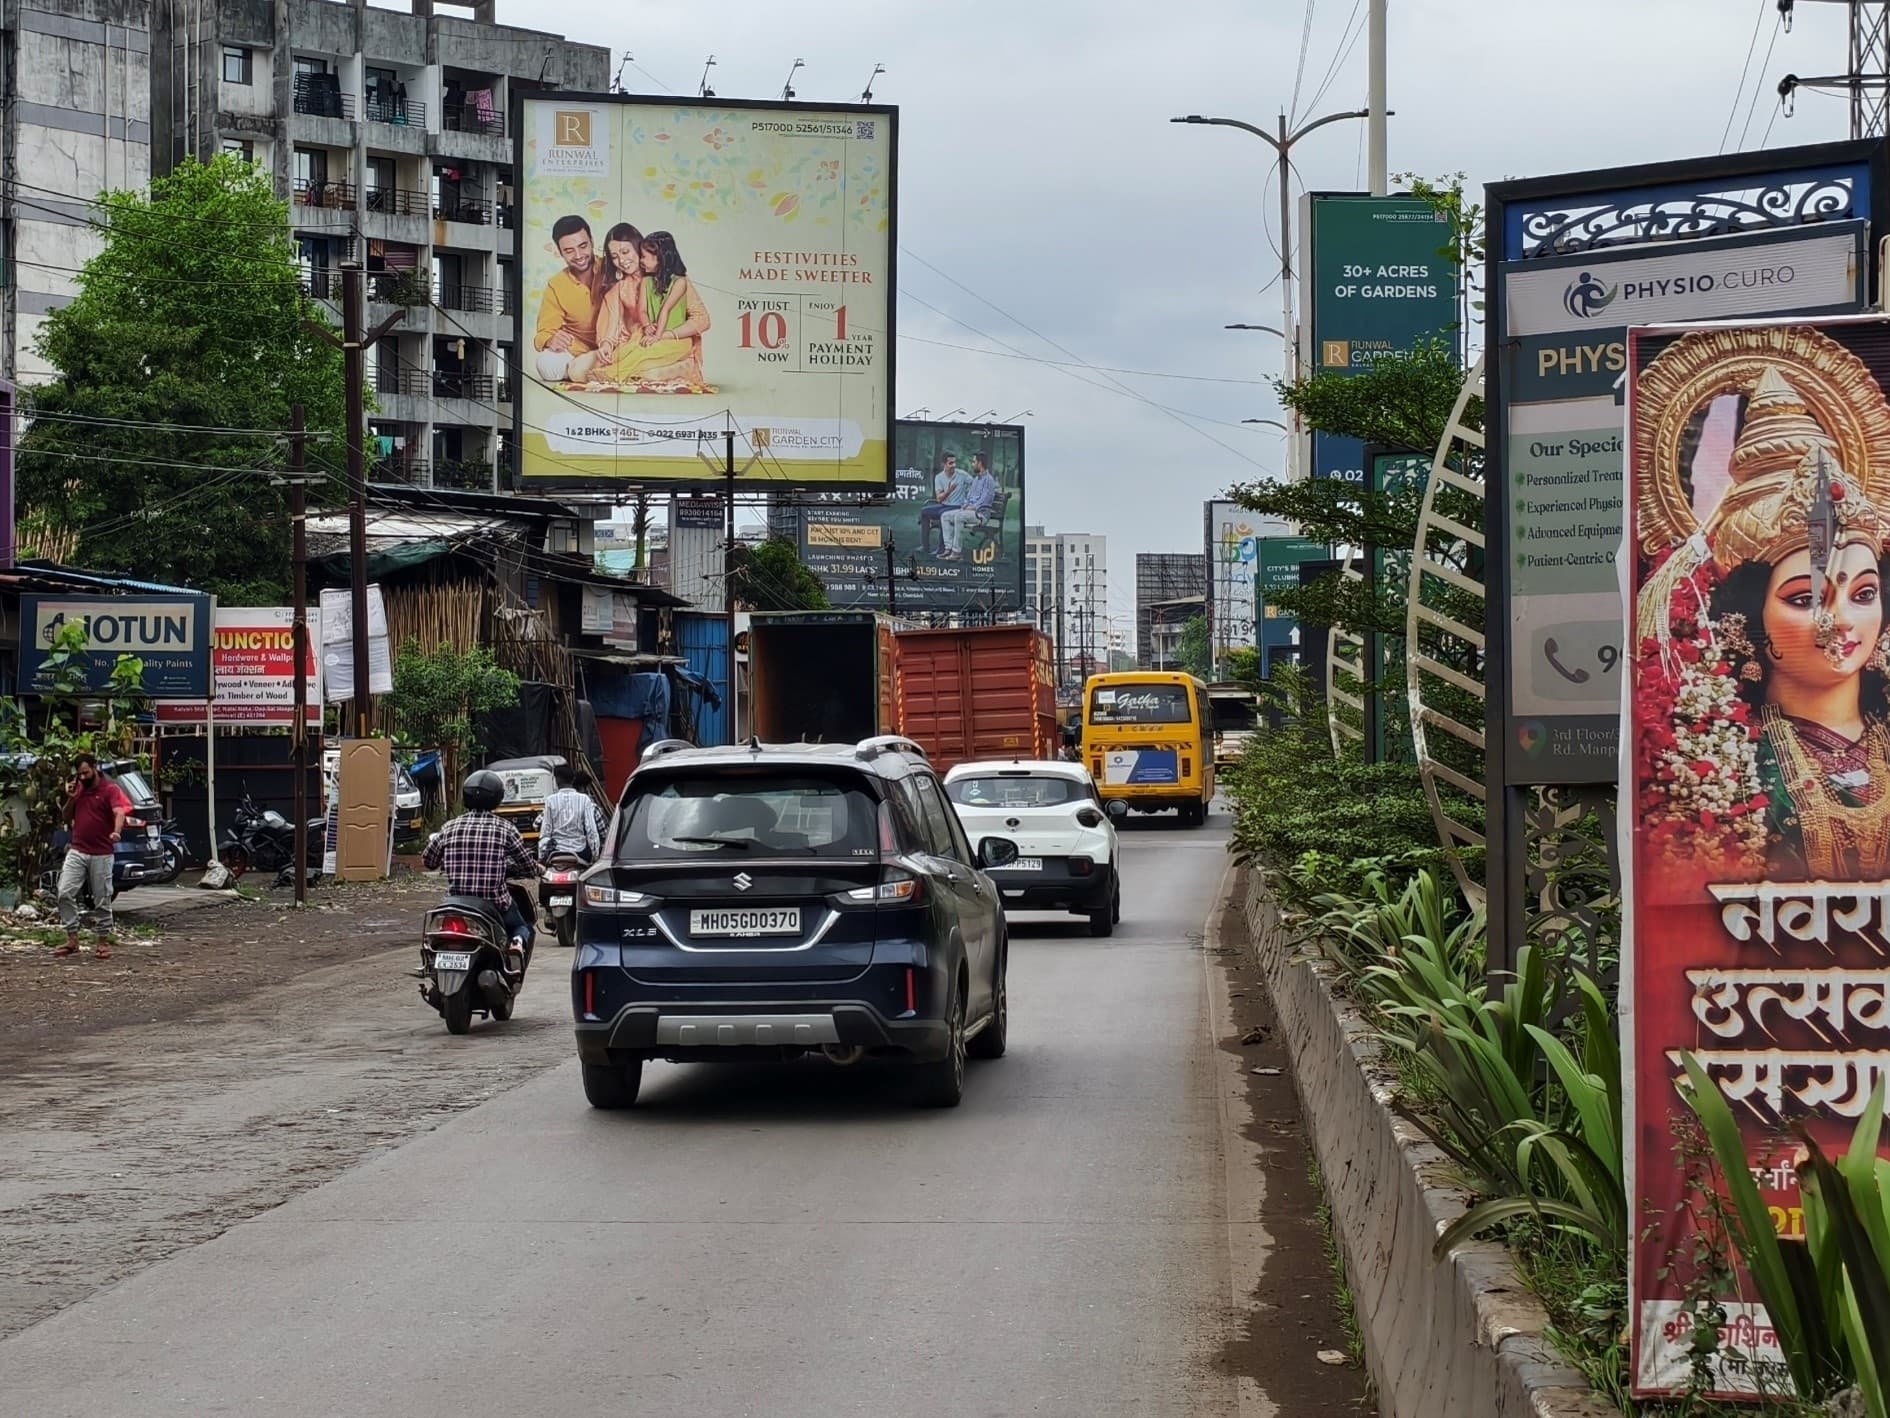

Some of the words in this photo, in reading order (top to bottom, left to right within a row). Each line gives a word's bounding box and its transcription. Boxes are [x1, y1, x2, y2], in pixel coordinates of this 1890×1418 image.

[560, 115, 585, 142] R
[548, 149, 598, 160] RUNWAL
[755, 251, 857, 266] FESTIVITIES
[739, 268, 788, 280] MADE
[795, 270, 872, 283] SWEETER
[1343, 265, 1372, 278] 30+
[1376, 266, 1429, 278] ACRES
[1335, 286, 1357, 298] OF
[1361, 286, 1438, 298] GARDENS
[738, 300, 760, 310] PAY
[762, 301, 790, 311] JUST
[809, 302, 836, 310] ENJOY
[832, 305, 849, 341] 1
[852, 334, 873, 342] YEAR
[809, 343, 874, 354] PAYMENT
[1351, 340, 1394, 350] RUNWAL
[758, 352, 789, 362] NOW
[809, 355, 873, 366] HOLIDAY
[1328, 344, 1345, 364] R
[1538, 342, 1625, 377] PHYS
[585, 428, 611, 437] BHKs
[772, 435, 817, 445] GARDEN
[820, 436, 843, 445] CITY
[1530, 441, 1564, 457] Our
[1526, 470, 1590, 486] Personalized
[1527, 498, 1587, 515] Experienced
[1589, 496, 1623, 512] Physio
[1527, 524, 1576, 539] Advanced
[1527, 552, 1603, 567] Patient-Centric
[83, 615, 187, 644] JOTUN
[214, 632, 295, 650] JUNCTIO
[94, 659, 109, 667] No.
[166, 660, 192, 668] Paints
[228, 691, 253, 699] Timber
[256, 691, 264, 699] of
[266, 691, 288, 699] Wood
[1553, 729, 1572, 740] 3rd
[1580, 743, 1618, 757] Manp
[701, 912, 797, 930] MH05GD0370
